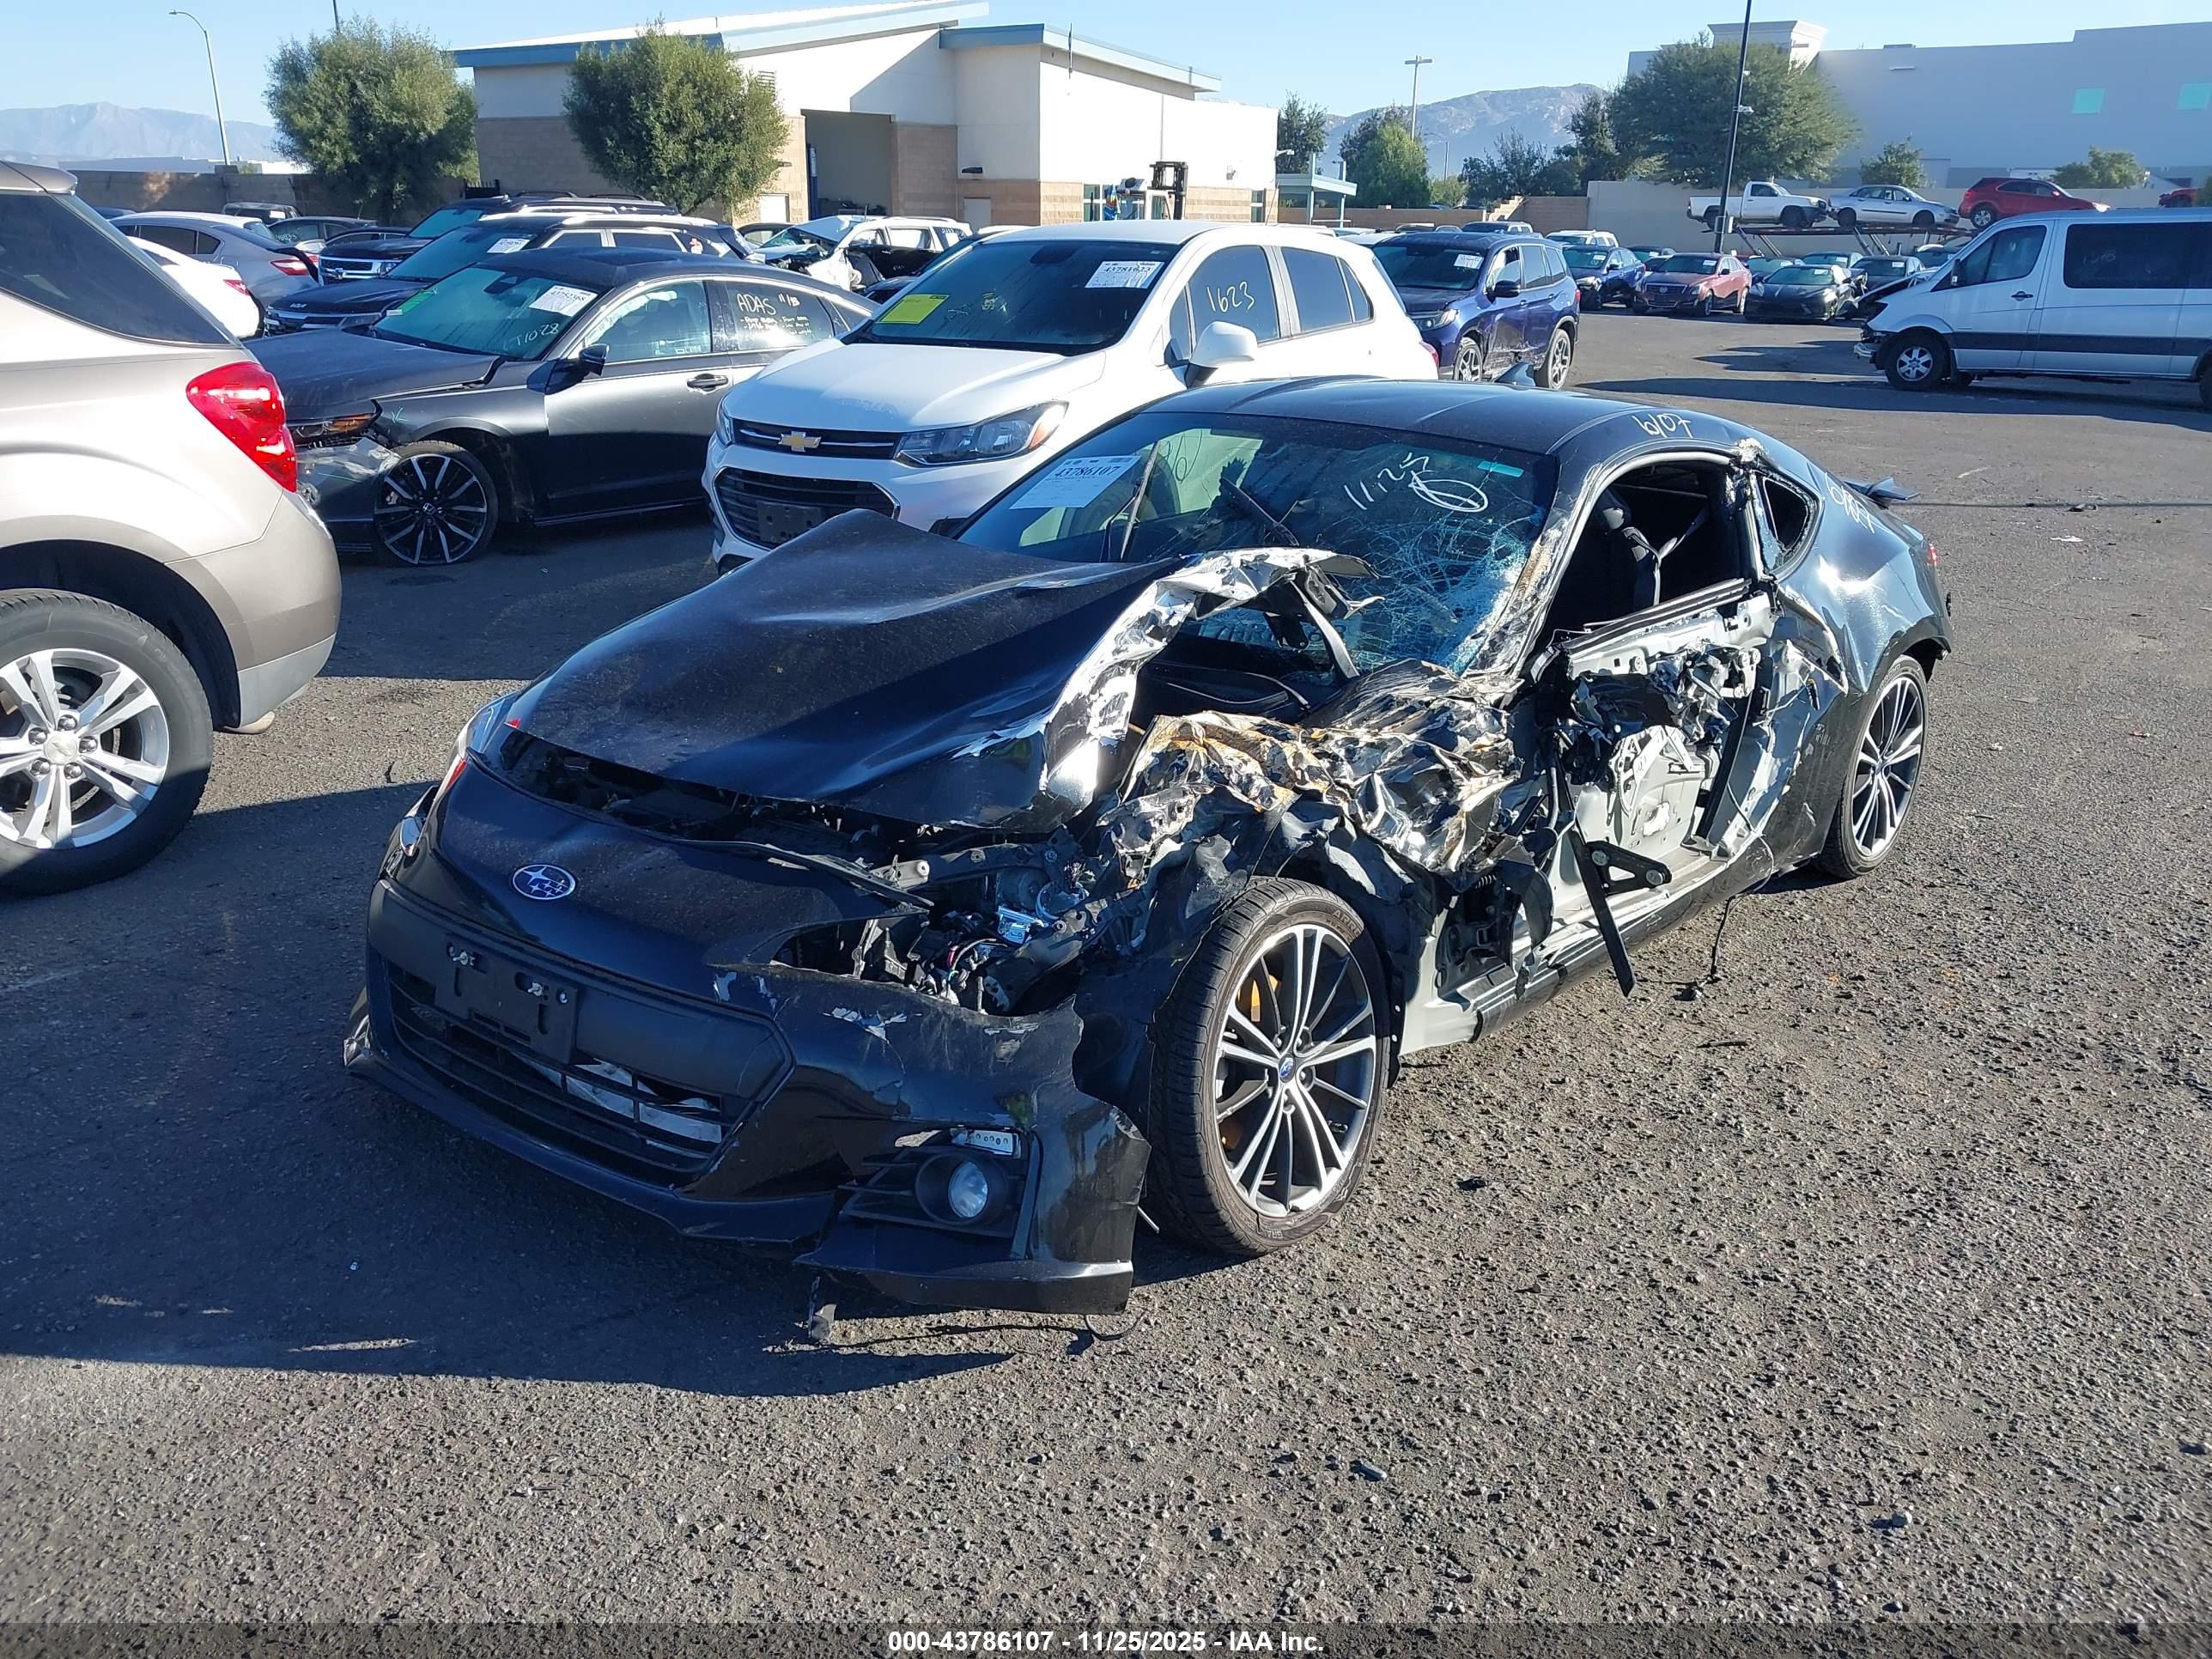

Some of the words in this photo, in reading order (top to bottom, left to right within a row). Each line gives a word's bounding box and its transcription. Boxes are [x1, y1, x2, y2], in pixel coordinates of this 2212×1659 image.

[737, 293, 776, 315] ADAS
[1206, 281, 1255, 313] 1623
[1054, 465, 1122, 477] 43786107
